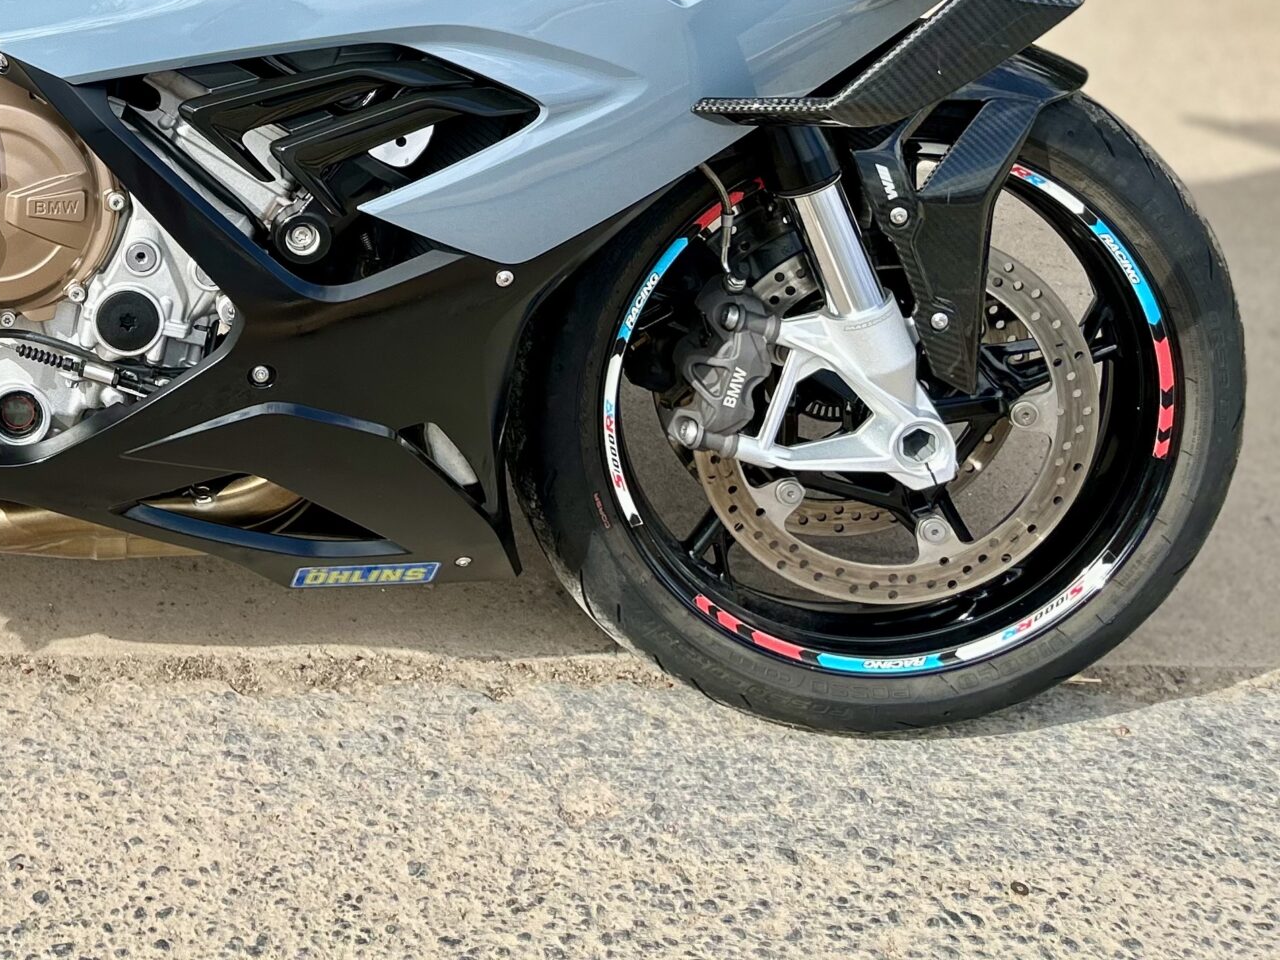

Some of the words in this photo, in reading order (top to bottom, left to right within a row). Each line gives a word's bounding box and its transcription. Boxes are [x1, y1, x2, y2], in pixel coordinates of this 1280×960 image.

[34, 200, 79, 215] BMW
[1099, 234, 1141, 284] RACING
[625, 271, 660, 327] RACING
[723, 366, 747, 408] BMW
[304, 568, 427, 585] ÖHLINS
[863, 655, 926, 669] RACING
